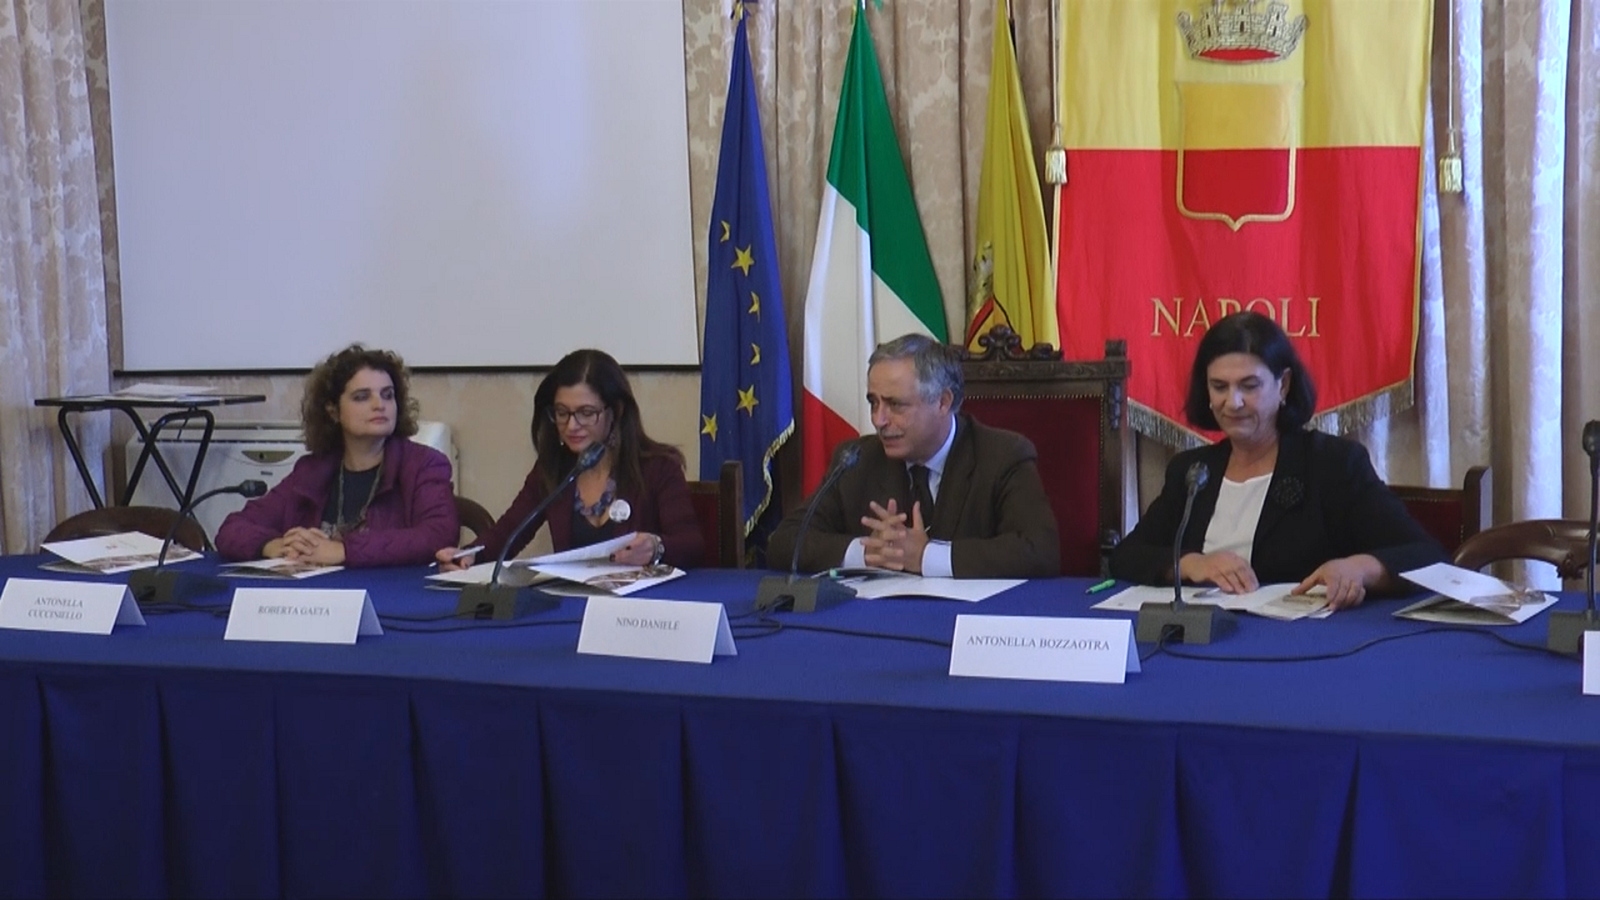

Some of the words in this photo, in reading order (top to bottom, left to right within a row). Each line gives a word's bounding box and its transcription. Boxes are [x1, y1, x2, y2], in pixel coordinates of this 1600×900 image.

[35, 597, 83, 608] ANTONELLA
[258, 605, 299, 615] ROBERTA
[300, 606, 331, 616] GAETA
[616, 617, 640, 628] NINO
[640, 619, 680, 630] DANIELE
[967, 635, 1036, 648] ANTONELLA
[1039, 637, 1110, 651] BOZZAOTRA
